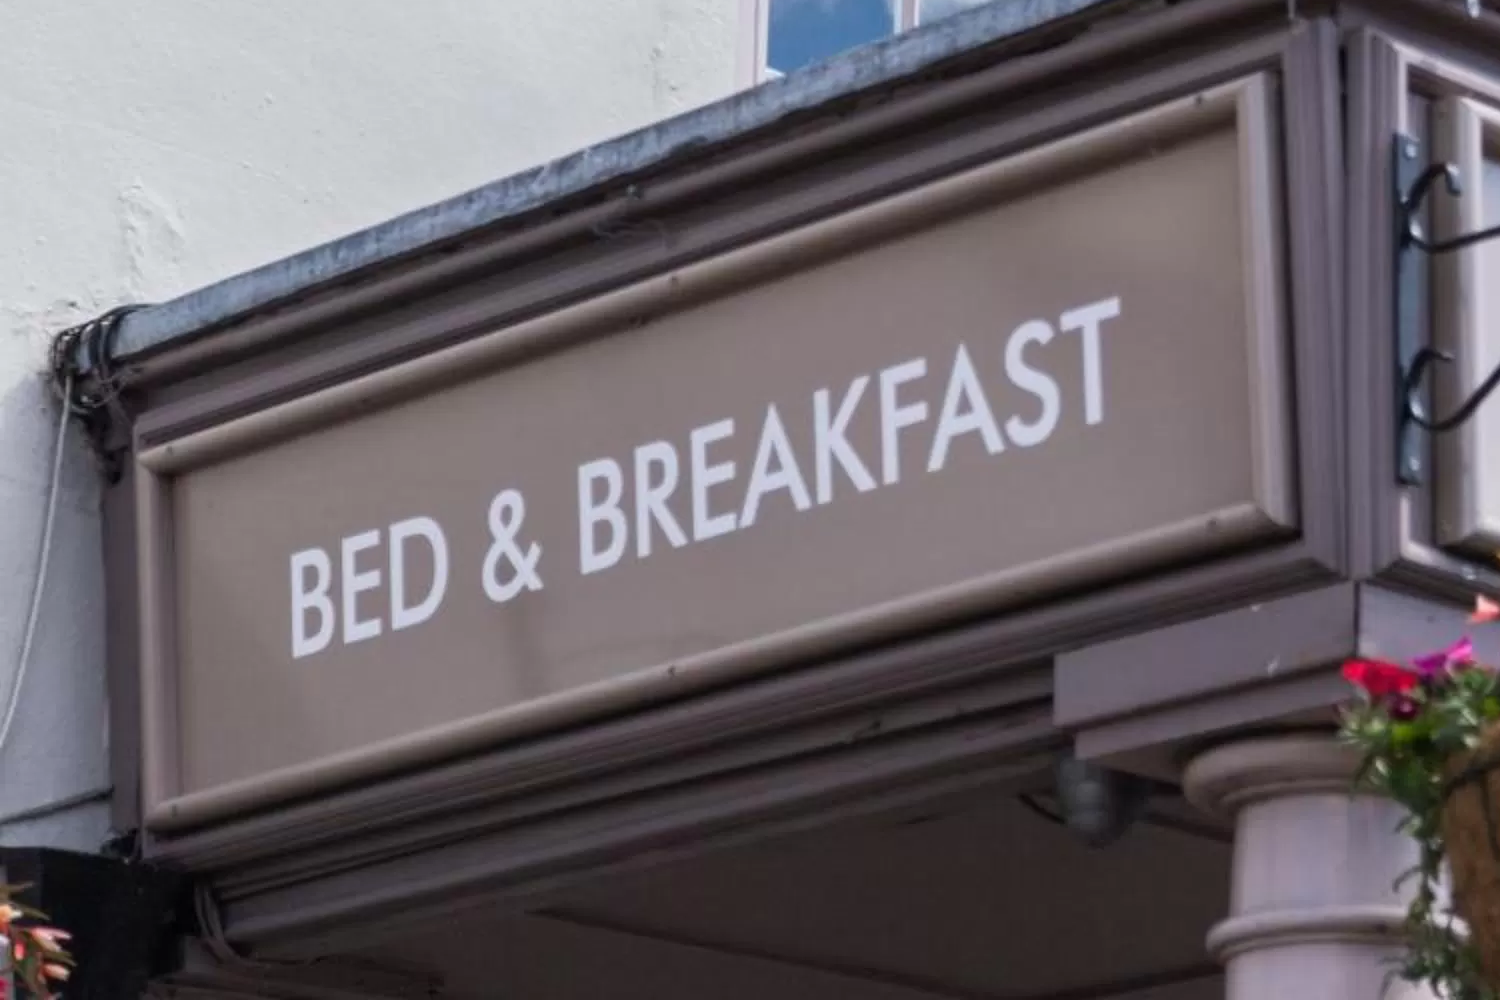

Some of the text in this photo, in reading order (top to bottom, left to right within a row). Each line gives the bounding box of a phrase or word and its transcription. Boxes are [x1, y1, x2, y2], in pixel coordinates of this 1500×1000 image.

[289, 296, 1121, 658] BED & BREAKFAST
